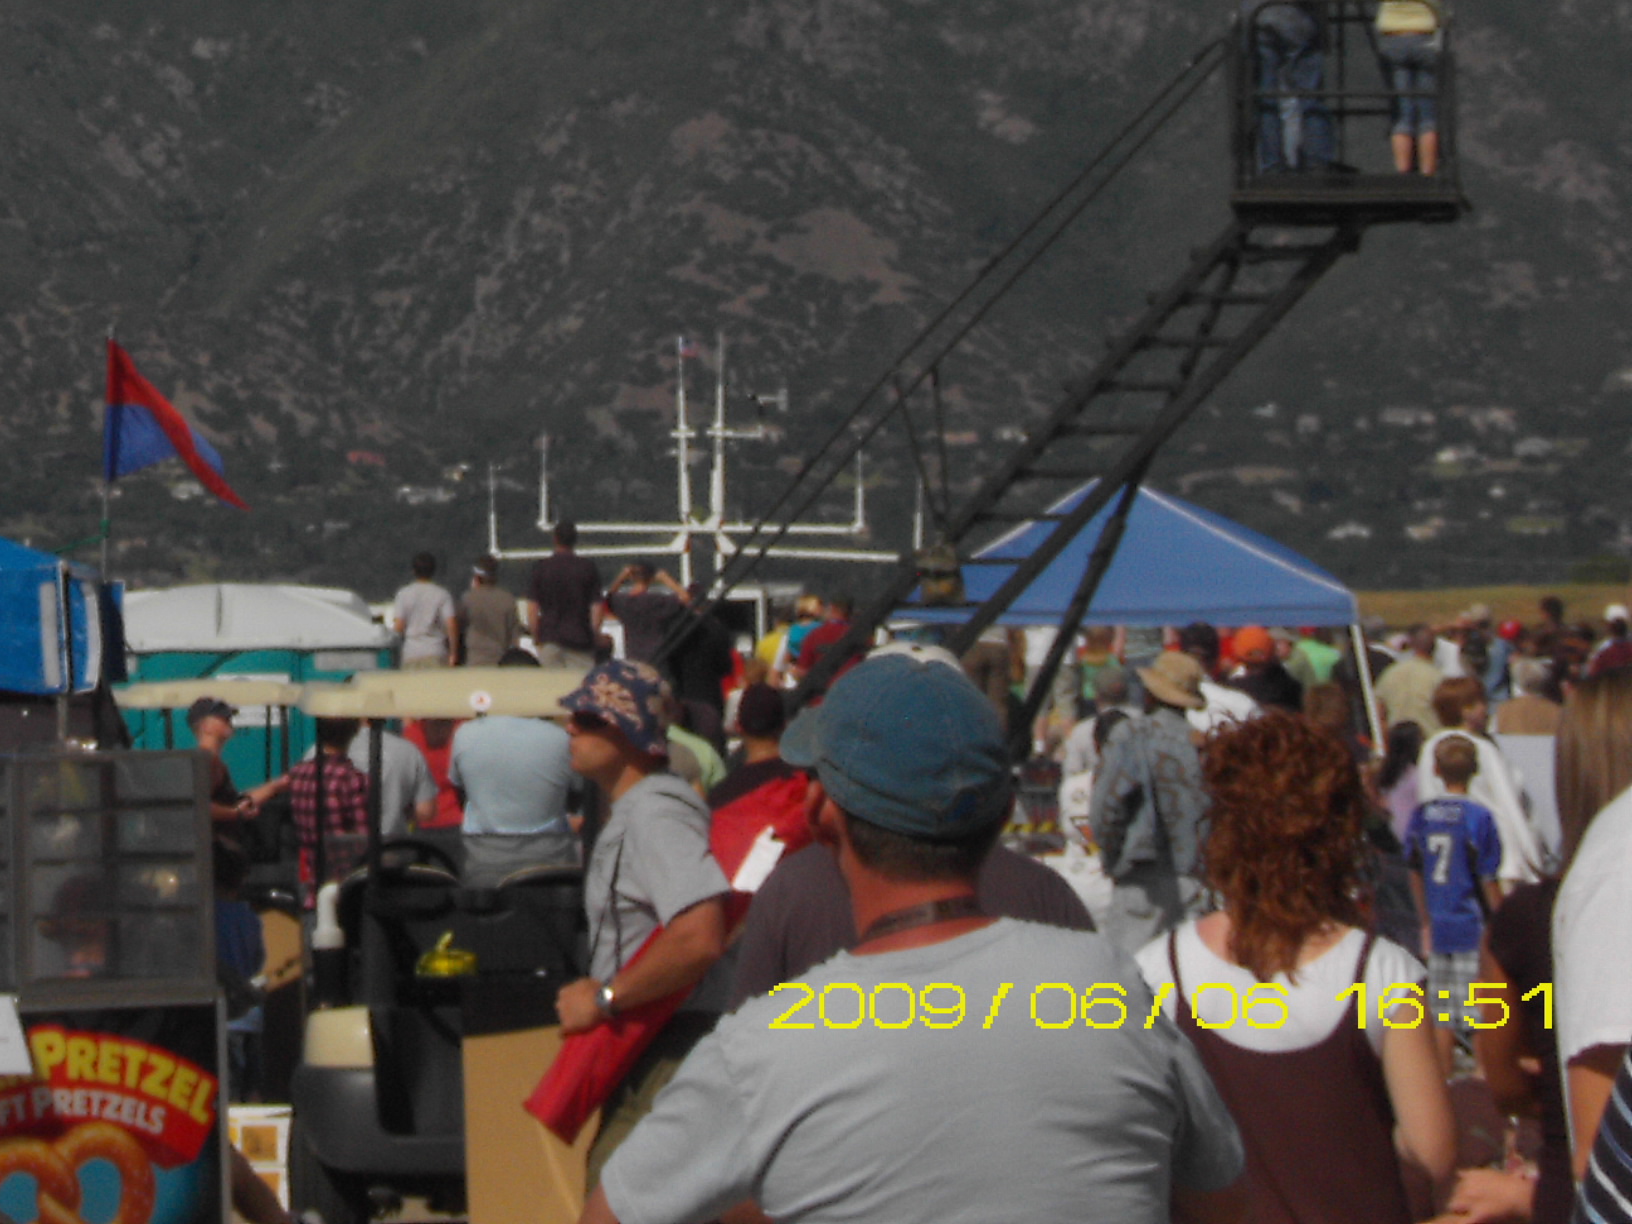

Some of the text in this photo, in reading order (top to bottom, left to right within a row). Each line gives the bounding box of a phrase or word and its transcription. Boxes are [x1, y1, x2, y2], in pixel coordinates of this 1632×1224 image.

[1428, 835, 1451, 883] 7
[30, 1029, 213, 1125] PRETZEL
[32, 1086, 166, 1135] PRETZELS
